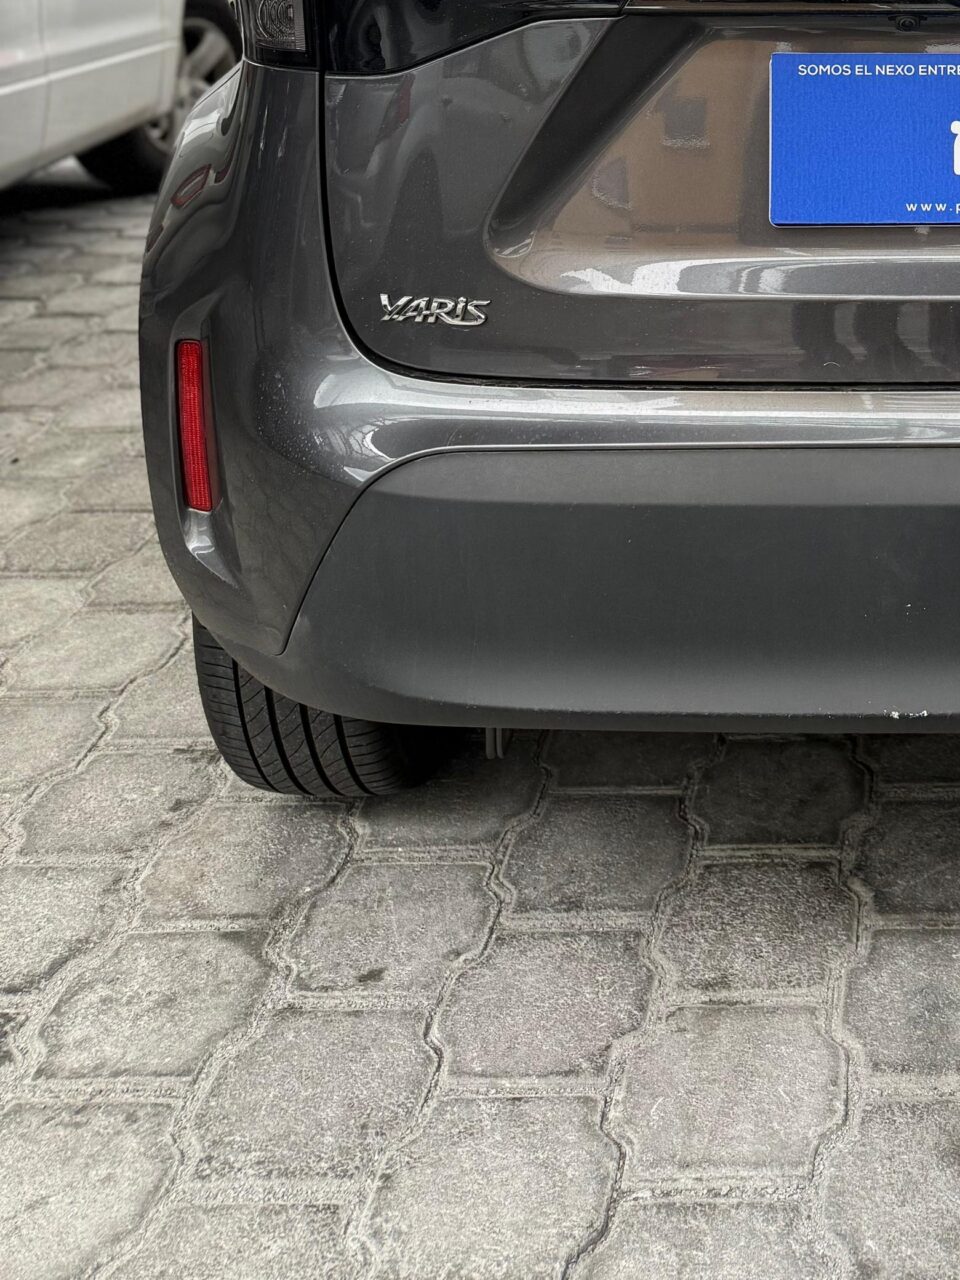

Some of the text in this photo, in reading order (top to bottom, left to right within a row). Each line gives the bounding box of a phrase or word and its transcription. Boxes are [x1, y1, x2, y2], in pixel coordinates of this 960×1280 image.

[798, 64, 851, 76] SOMOS
[855, 64, 872, 76] EL
[875, 64, 915, 76] NEXO
